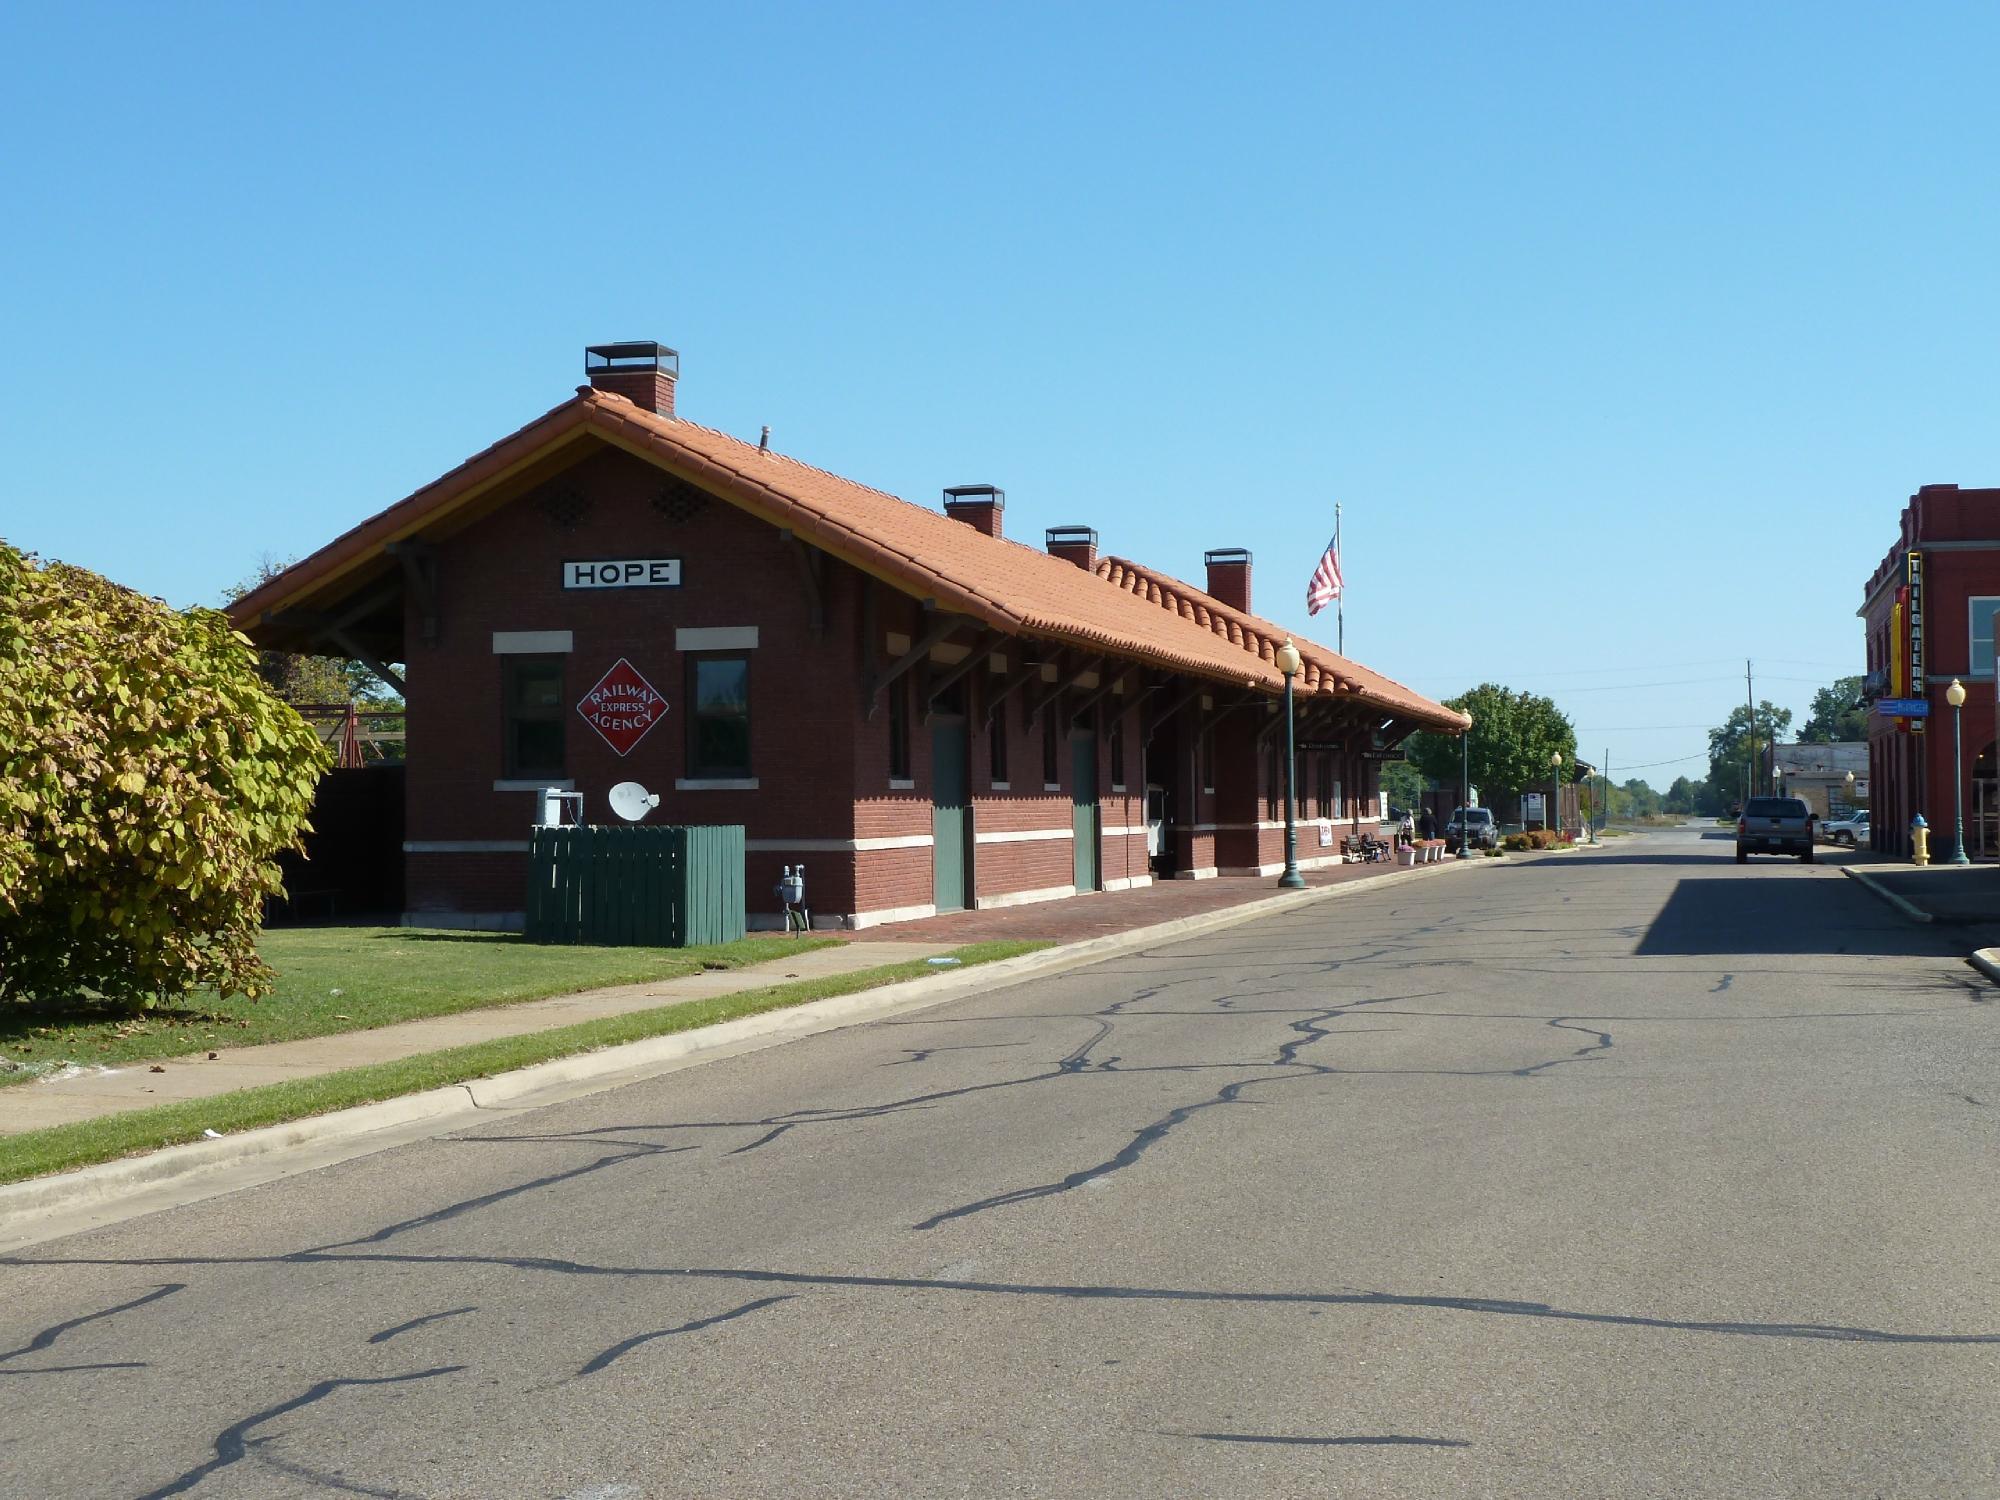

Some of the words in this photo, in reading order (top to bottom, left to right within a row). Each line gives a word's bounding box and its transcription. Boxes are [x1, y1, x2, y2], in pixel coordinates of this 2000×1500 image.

[575, 563, 670, 585] HOPE
[1911, 559, 1921, 692] TAILGATERS
[590, 684, 658, 705] RAILWAY
[601, 702, 645, 712] EXPRESS
[589, 709, 652, 731] AGENCY
